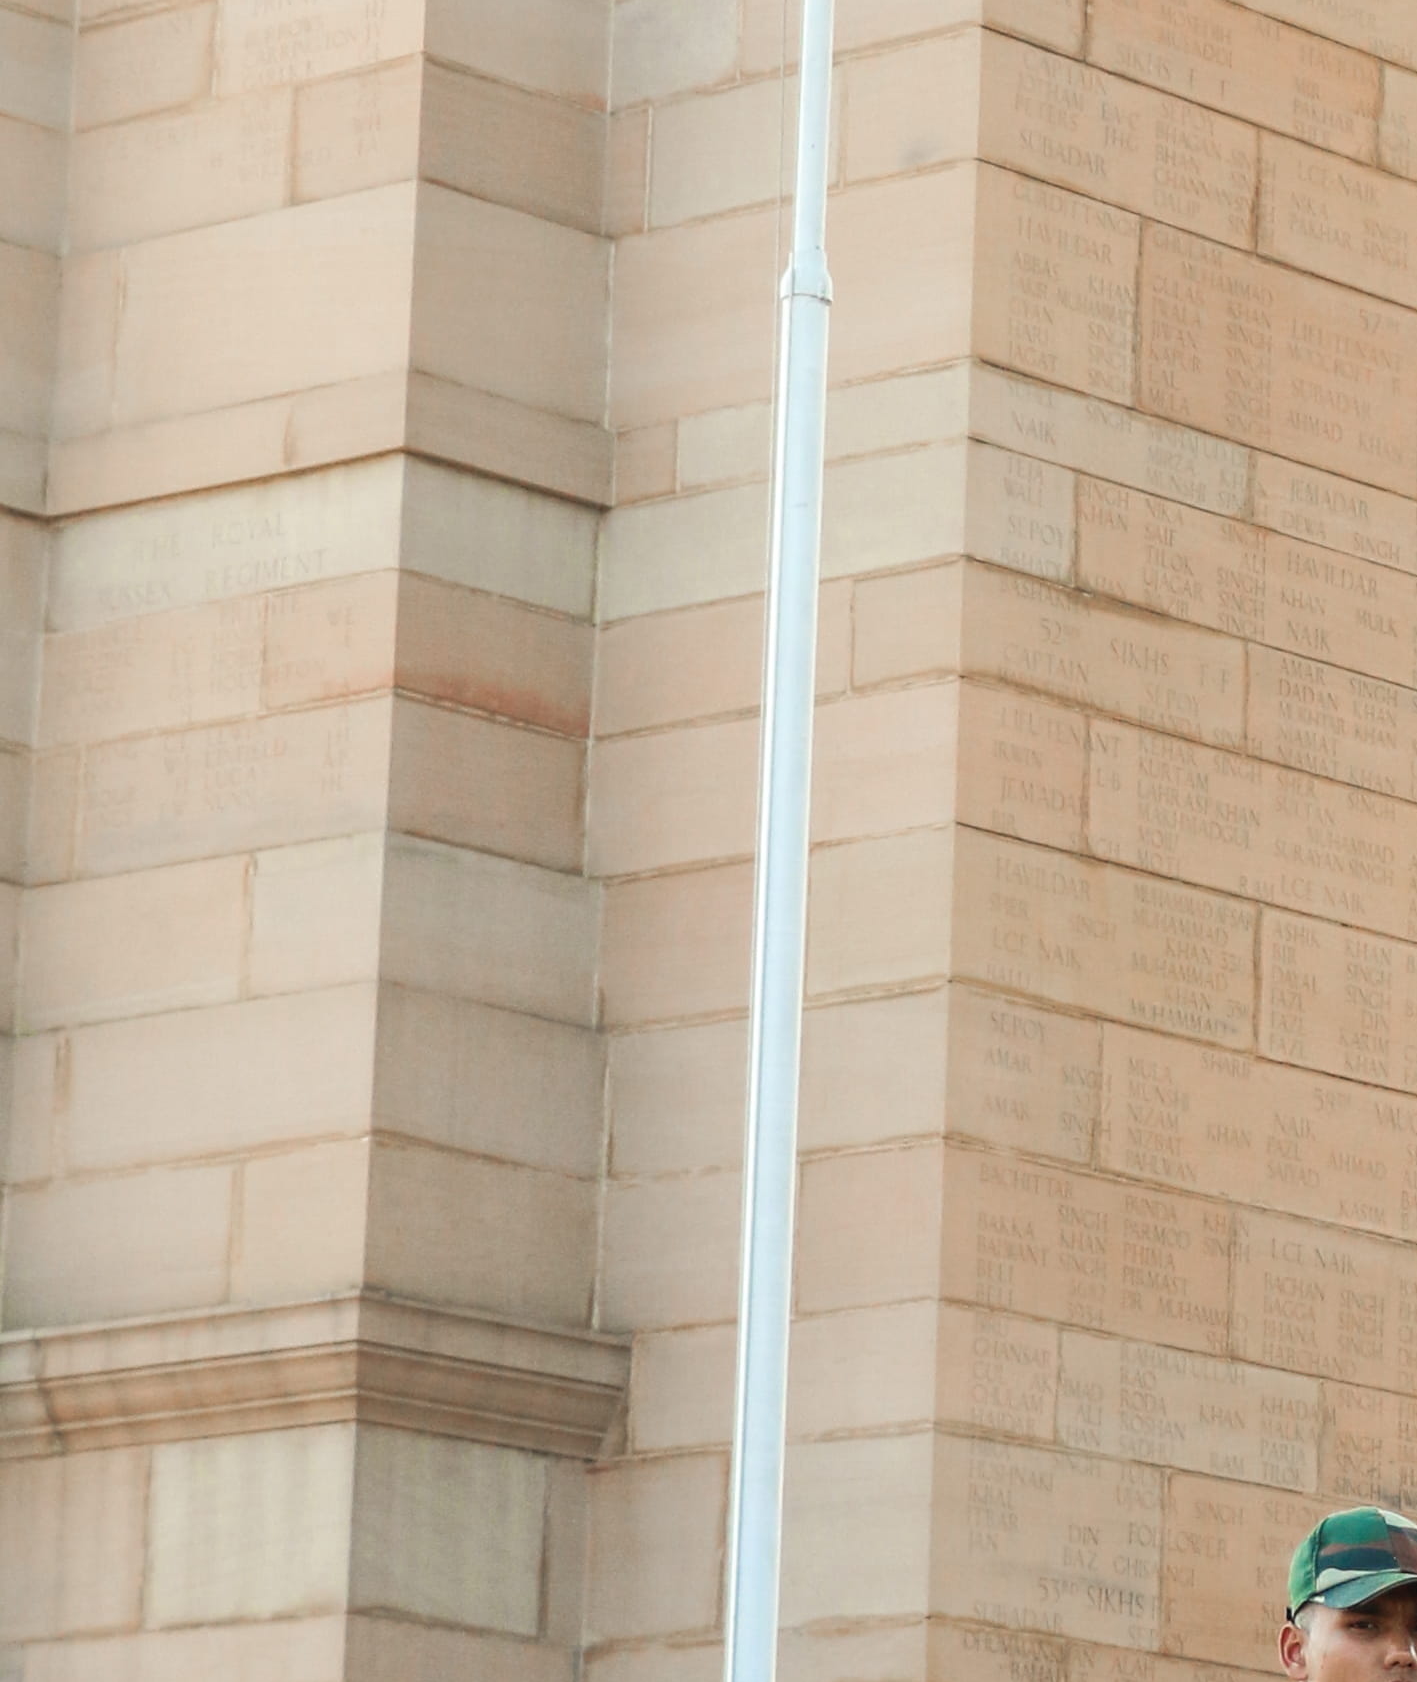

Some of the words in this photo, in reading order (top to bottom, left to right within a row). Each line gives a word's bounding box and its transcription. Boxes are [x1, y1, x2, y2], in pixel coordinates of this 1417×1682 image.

[1286, 550, 1378, 598] HAVILDAR
[1287, 620, 1331, 653] NAIK
[1038, 937, 1081, 969] NAIK
[1315, 1248, 1359, 1278] NAIK
[1087, 1584, 1145, 1618] SIKHS
